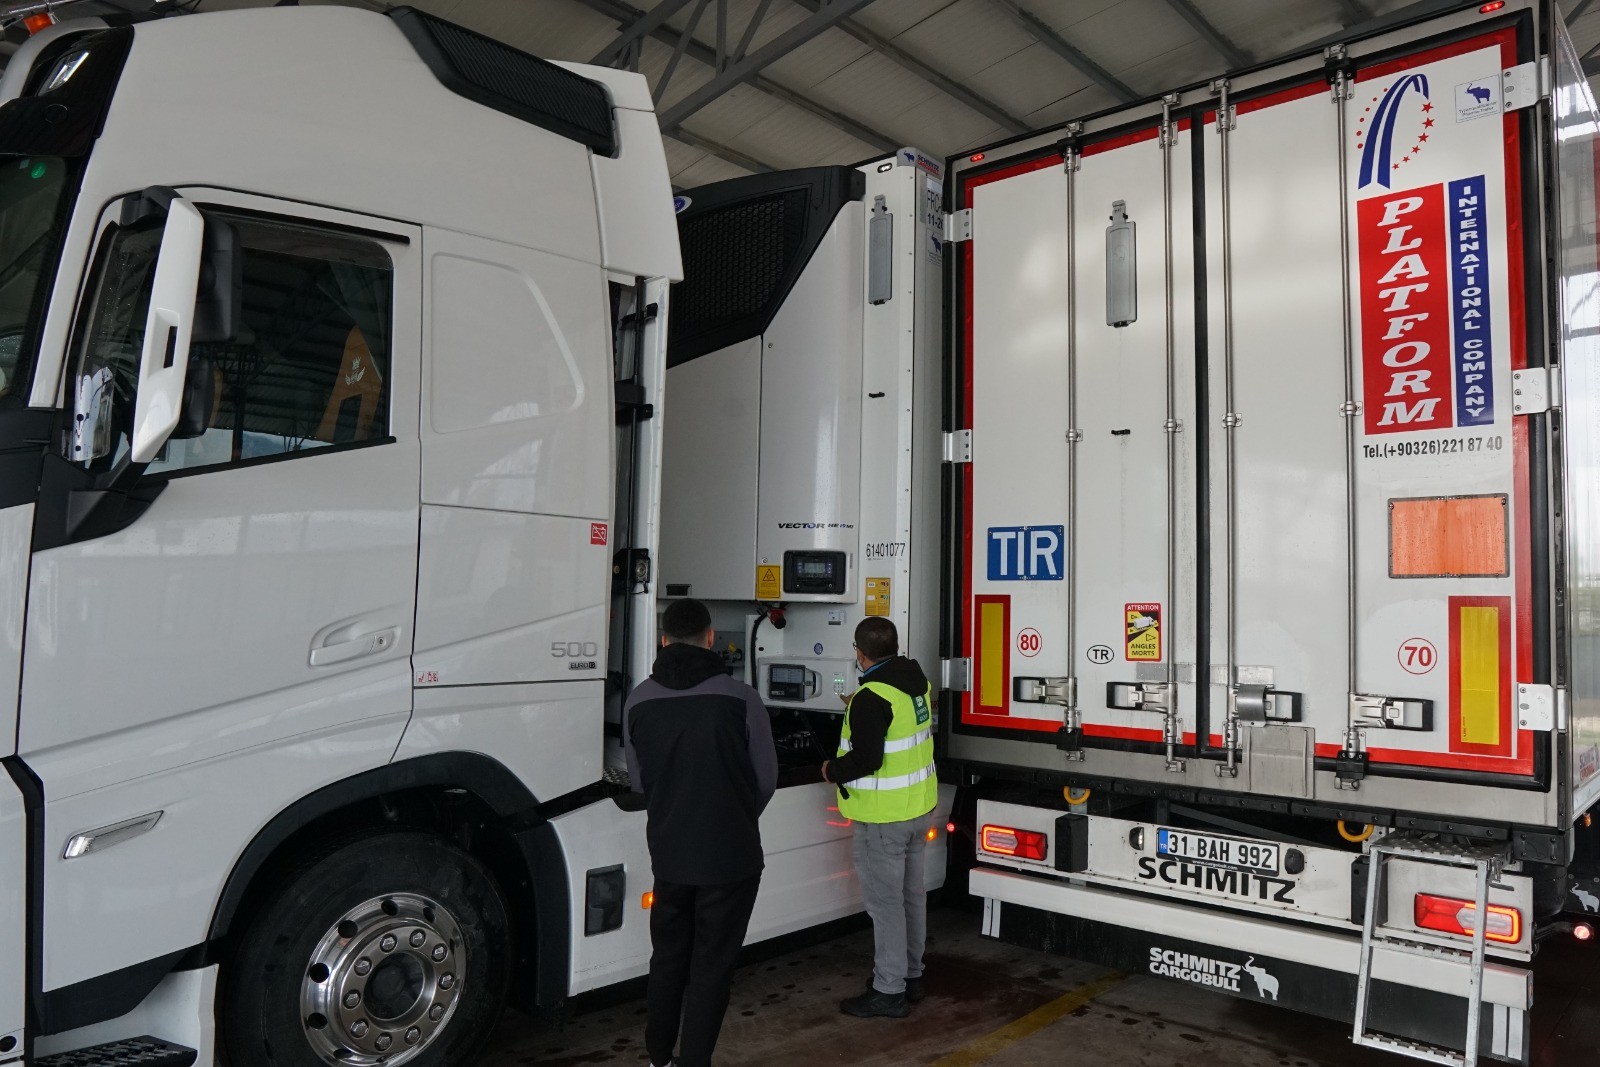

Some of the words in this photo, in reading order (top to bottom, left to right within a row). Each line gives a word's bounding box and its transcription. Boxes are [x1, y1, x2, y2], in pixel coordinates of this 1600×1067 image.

[918, 155, 940, 172] SCHMITZ
[1458, 186, 1482, 330] INTERNATIONAL
[1377, 196, 1441, 426] PLATFORM
[1462, 339, 1486, 417] COMPANY
[866, 542, 906, 558] 61401077
[992, 530, 1059, 576] TIR
[551, 641, 598, 658] 500
[1020, 634, 1039, 651] 80
[1092, 649, 1109, 660] TR
[1404, 646, 1432, 667] 70
[1169, 833, 1188, 856] 31
[1197, 838, 1230, 862] BAH
[1238, 844, 1272, 869] 992
[1138, 856, 1296, 905] SCHMITZ
[1149, 947, 1242, 980] SCHMITZ
[1149, 961, 1241, 993] CARGOBULL
